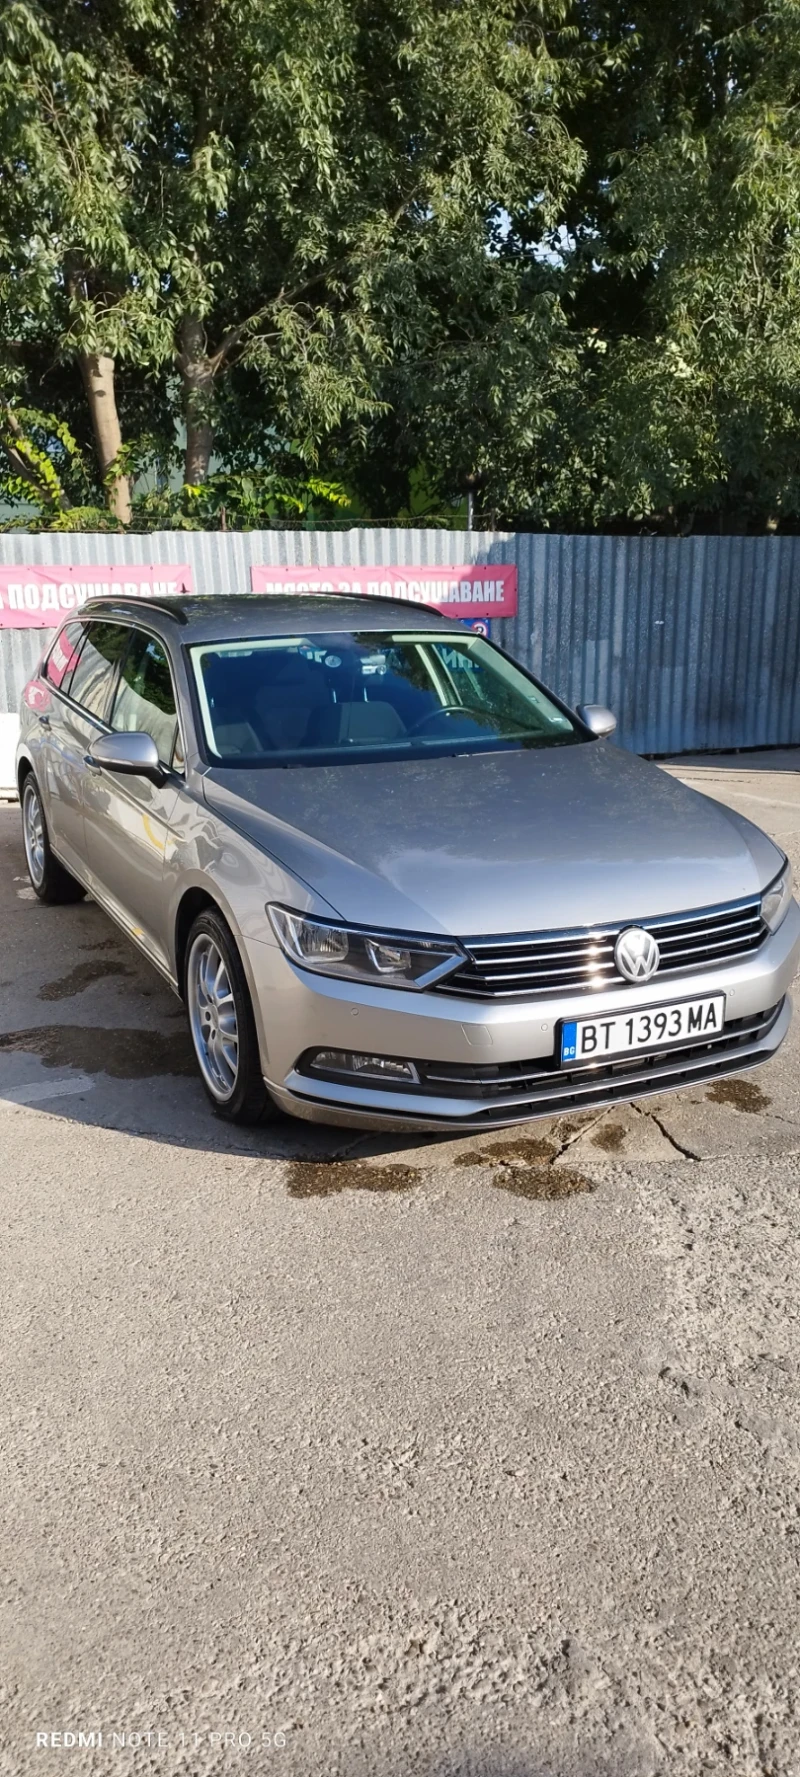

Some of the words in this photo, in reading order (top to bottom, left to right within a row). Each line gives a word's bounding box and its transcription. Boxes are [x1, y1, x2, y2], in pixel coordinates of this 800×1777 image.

[581, 1021, 616, 1054] BT
[625, 1009, 682, 1046] 1393
[687, 1002, 717, 1034] MA
[563, 1045, 575, 1057] BG
